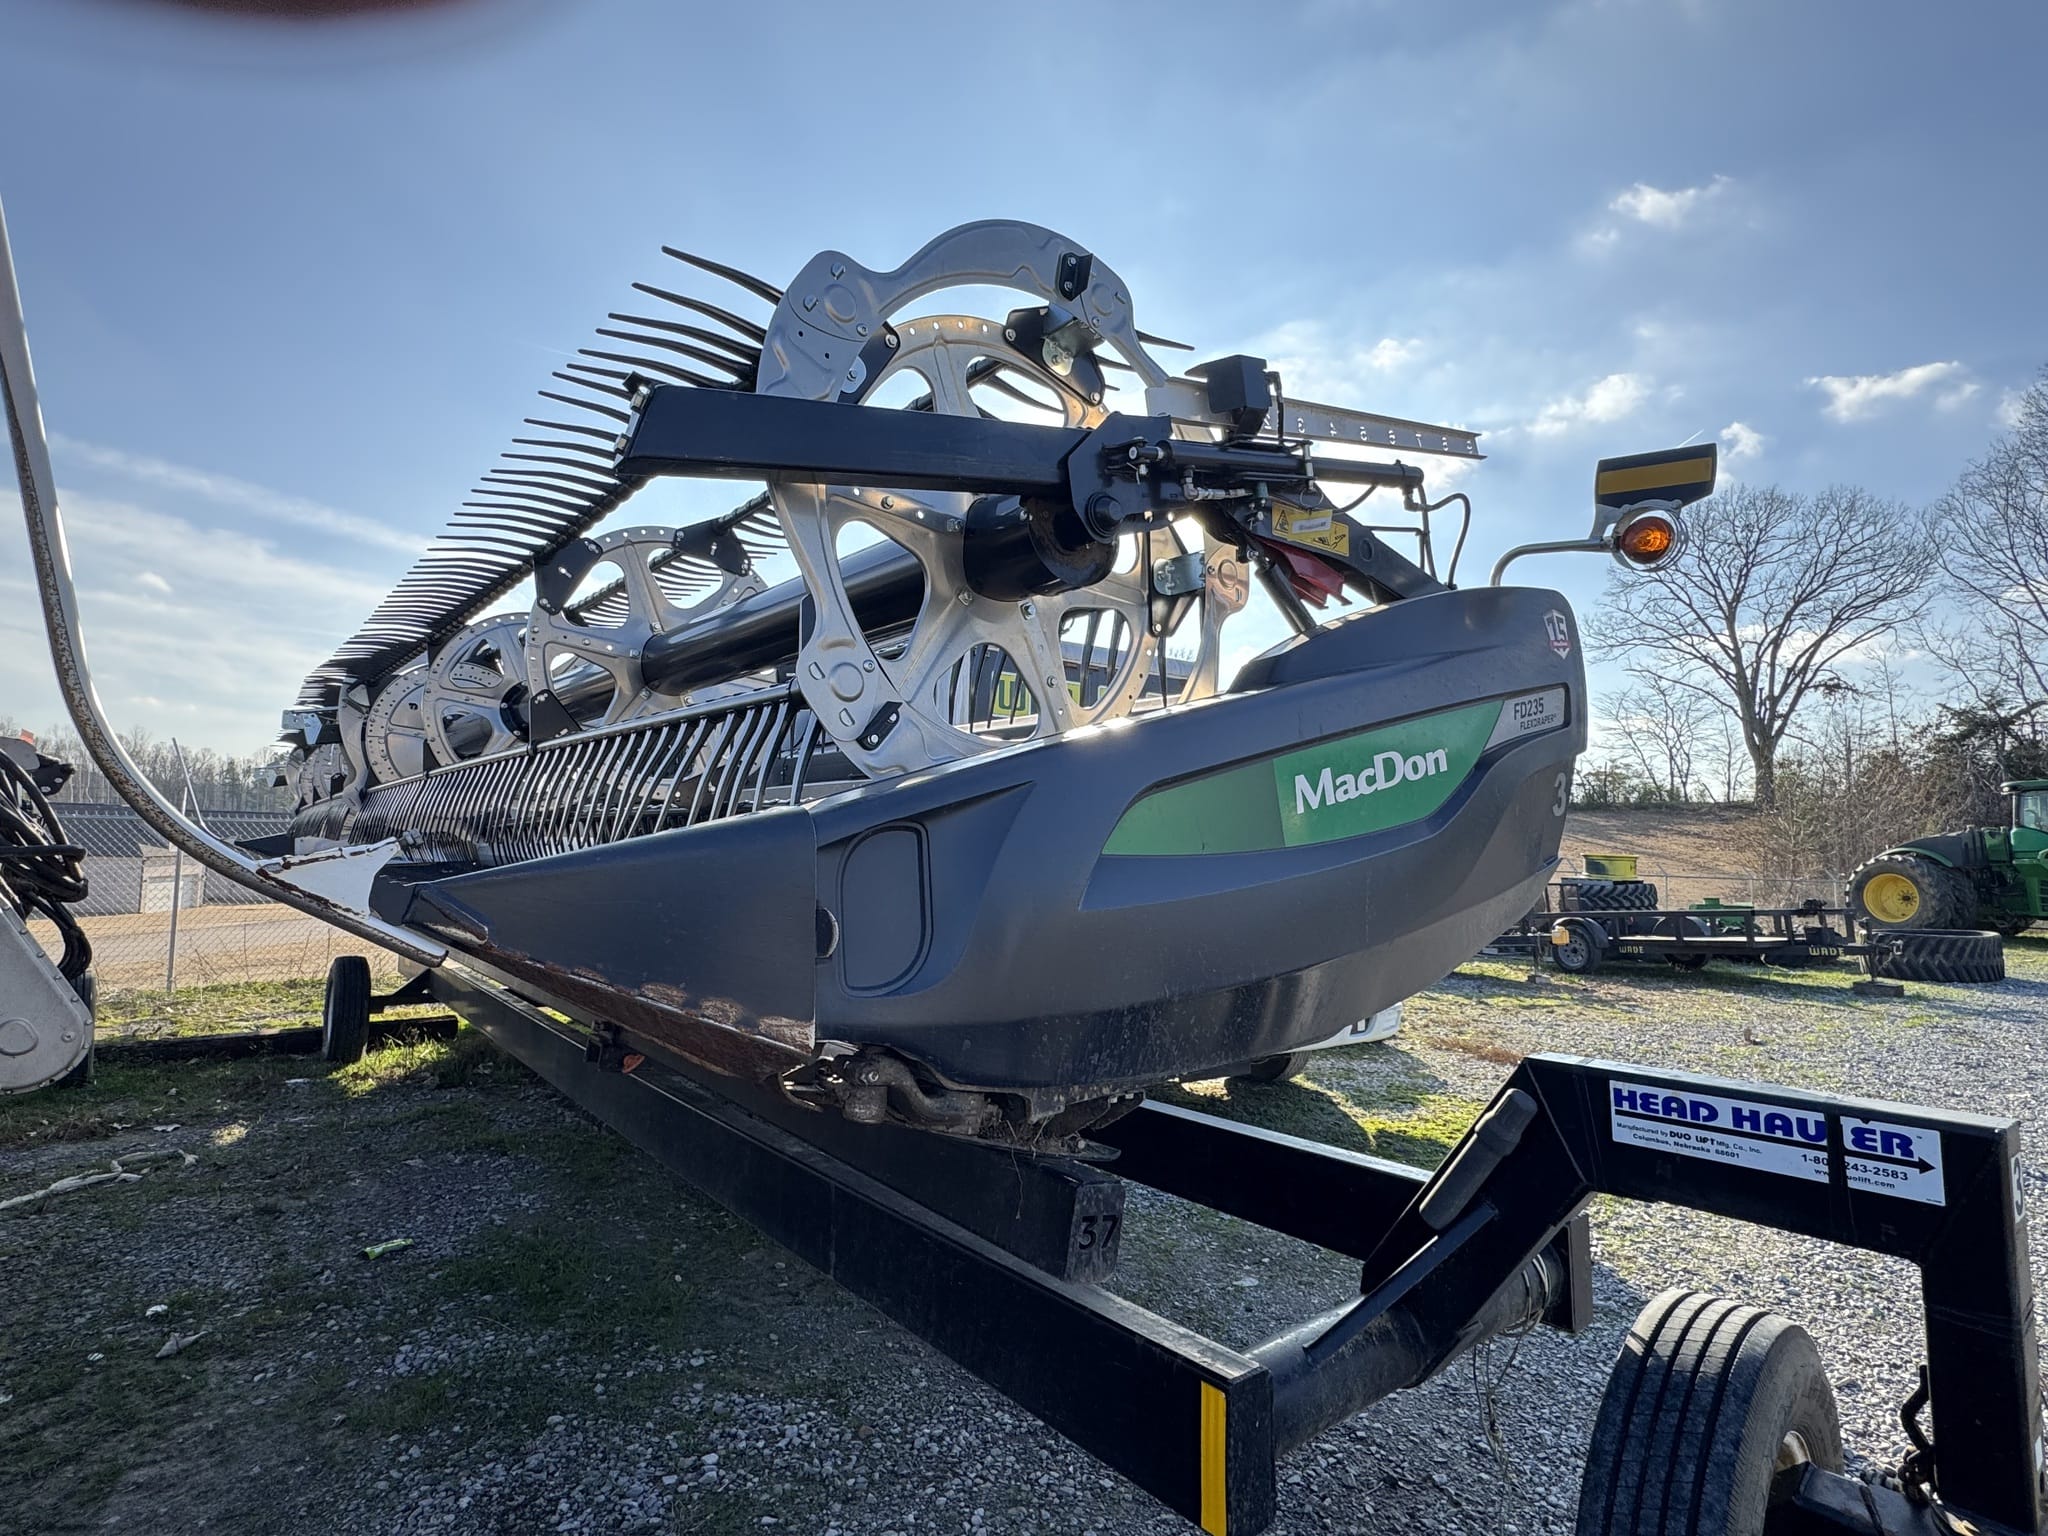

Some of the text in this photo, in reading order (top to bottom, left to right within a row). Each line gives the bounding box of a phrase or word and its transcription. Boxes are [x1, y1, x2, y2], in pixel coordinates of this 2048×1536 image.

[1513, 697, 1545, 721] FD235
[1294, 748, 1448, 815] MacDon
[1552, 772, 1567, 817] 3
[1808, 946, 1845, 957] WADE
[1612, 1087, 1915, 1159] HEAD HAUER
[1616, 1121, 1659, 1135] Manufactured
[1660, 1129, 1669, 1138] by
[1669, 1130, 1692, 1141] DUO
[1632, 1133, 1672, 1147] Columbus,
[1673, 1141, 1711, 1153] Nebraska
[1078, 1214, 1120, 1250] 37
